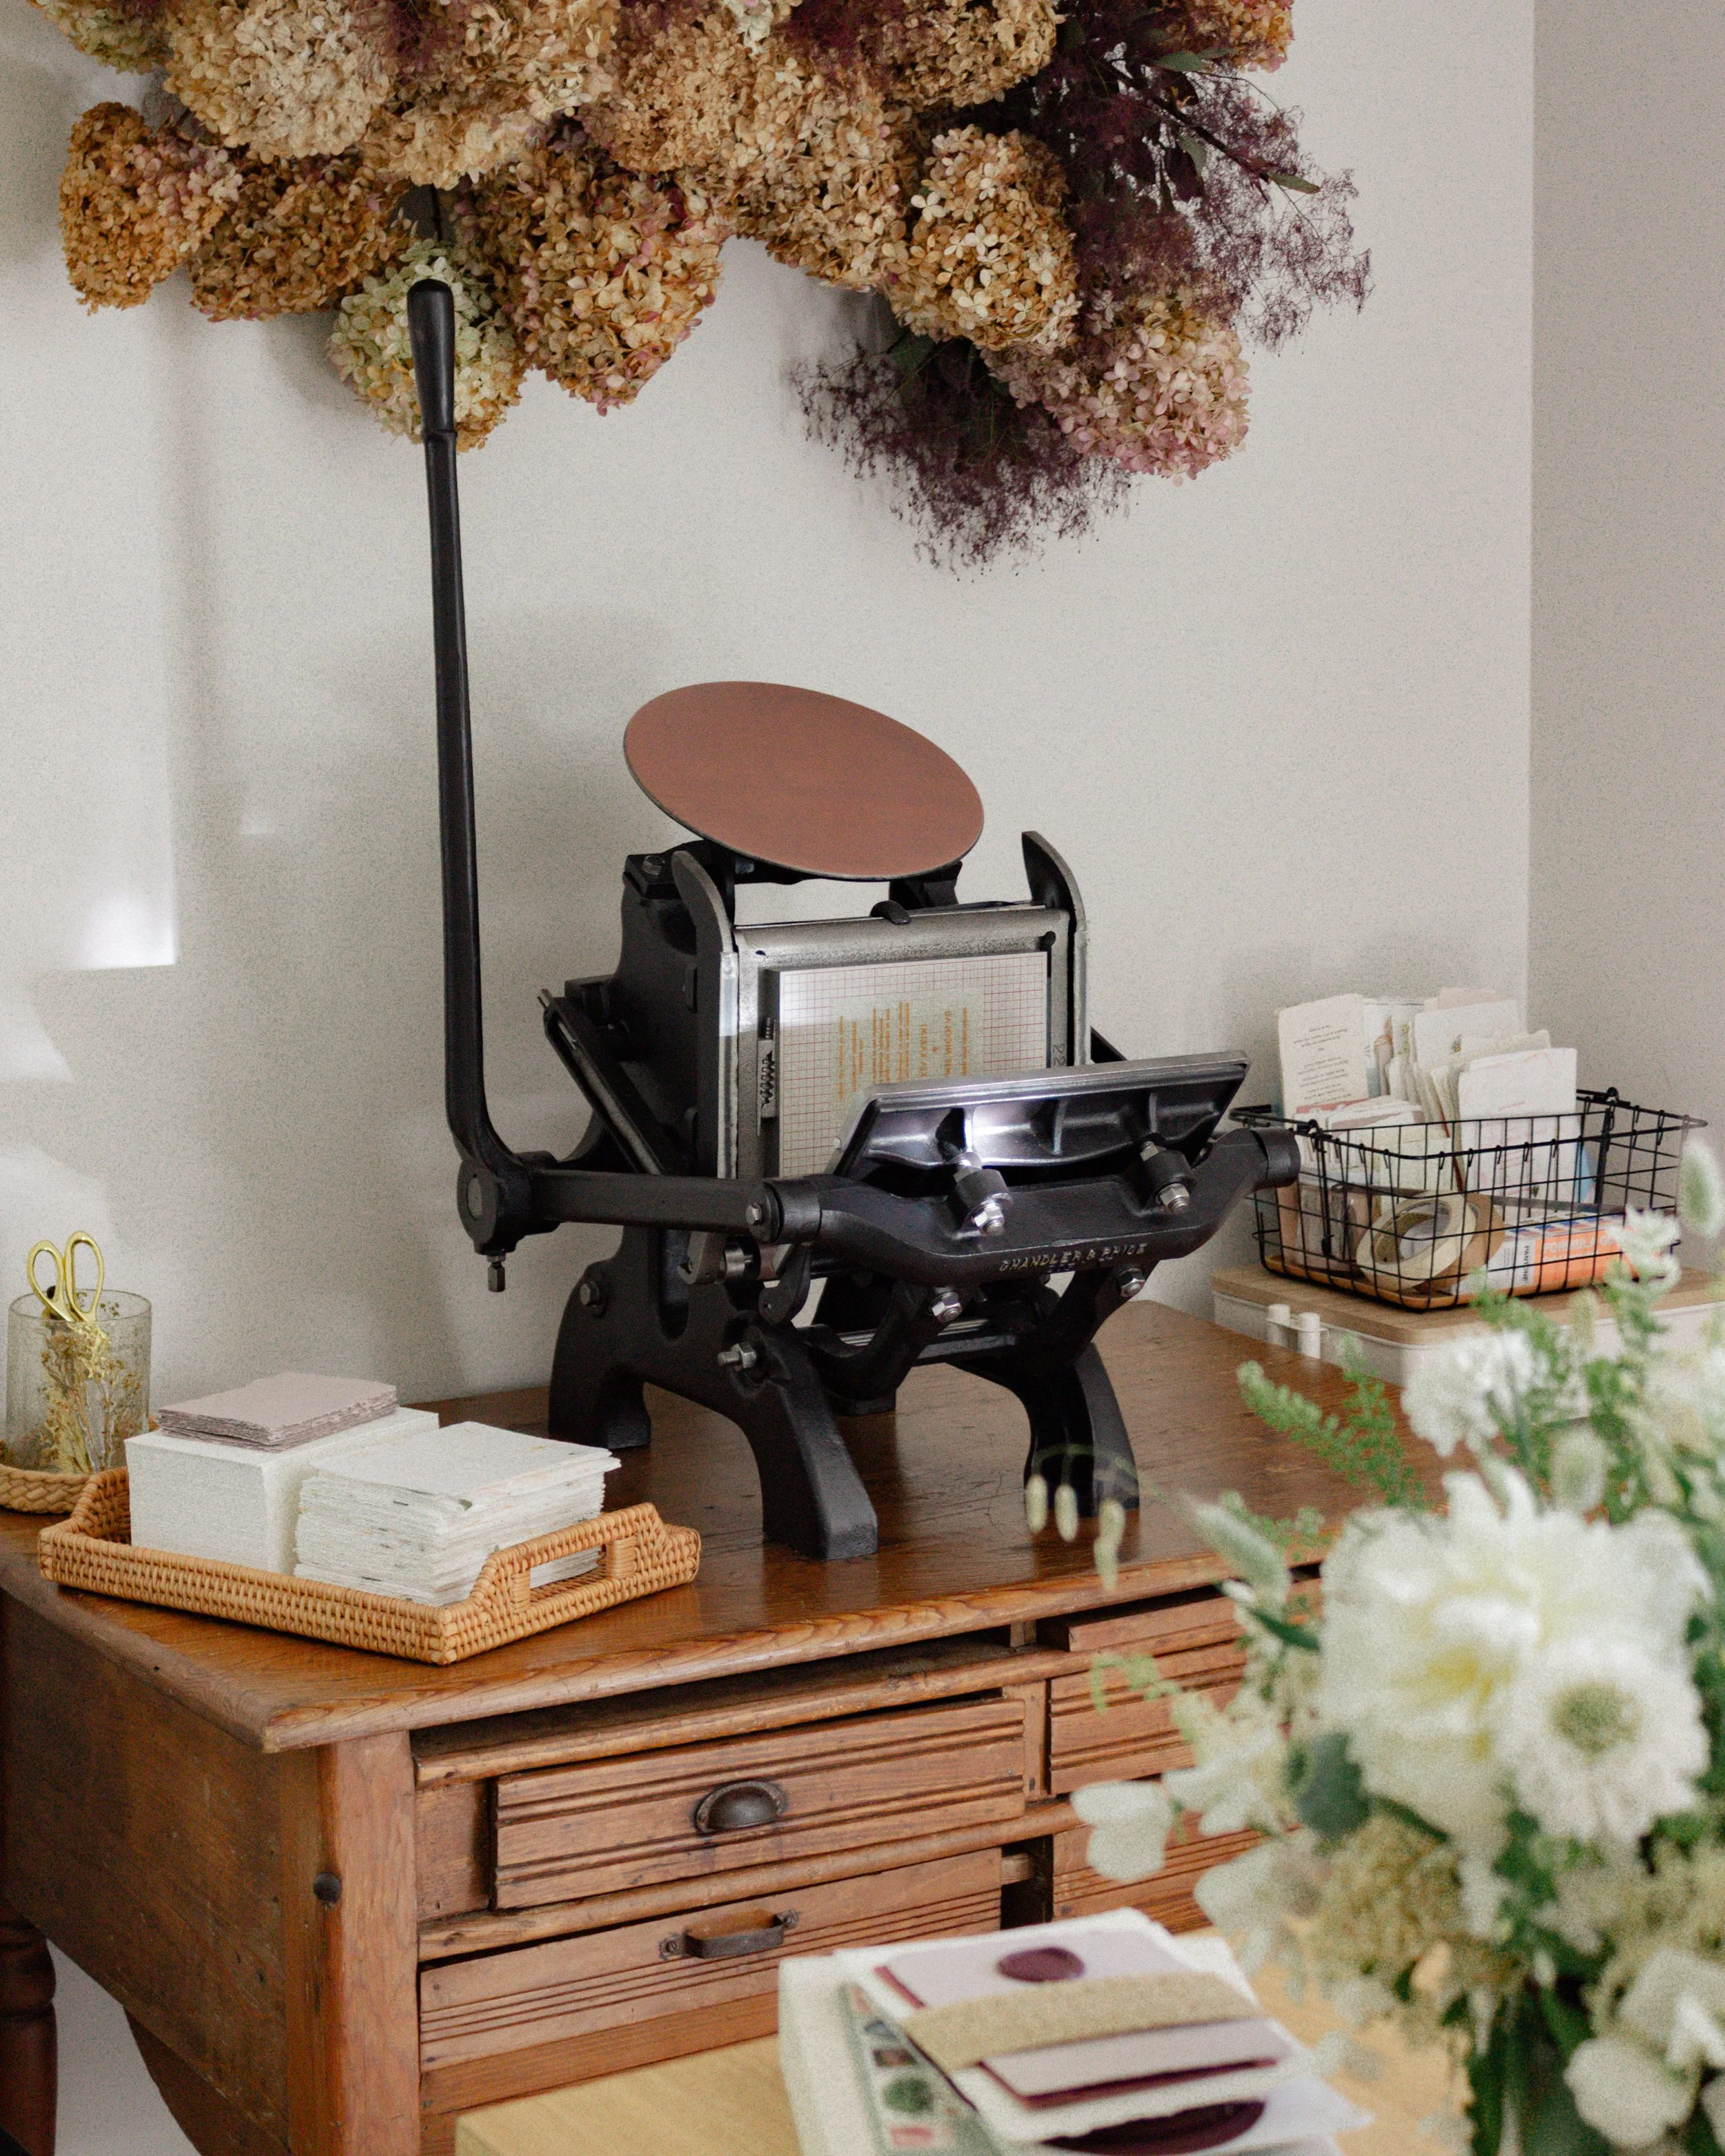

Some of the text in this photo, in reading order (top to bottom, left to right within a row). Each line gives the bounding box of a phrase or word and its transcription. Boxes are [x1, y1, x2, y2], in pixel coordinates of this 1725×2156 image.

[998, 1243, 1148, 1272] CHANDLER & PRICE
